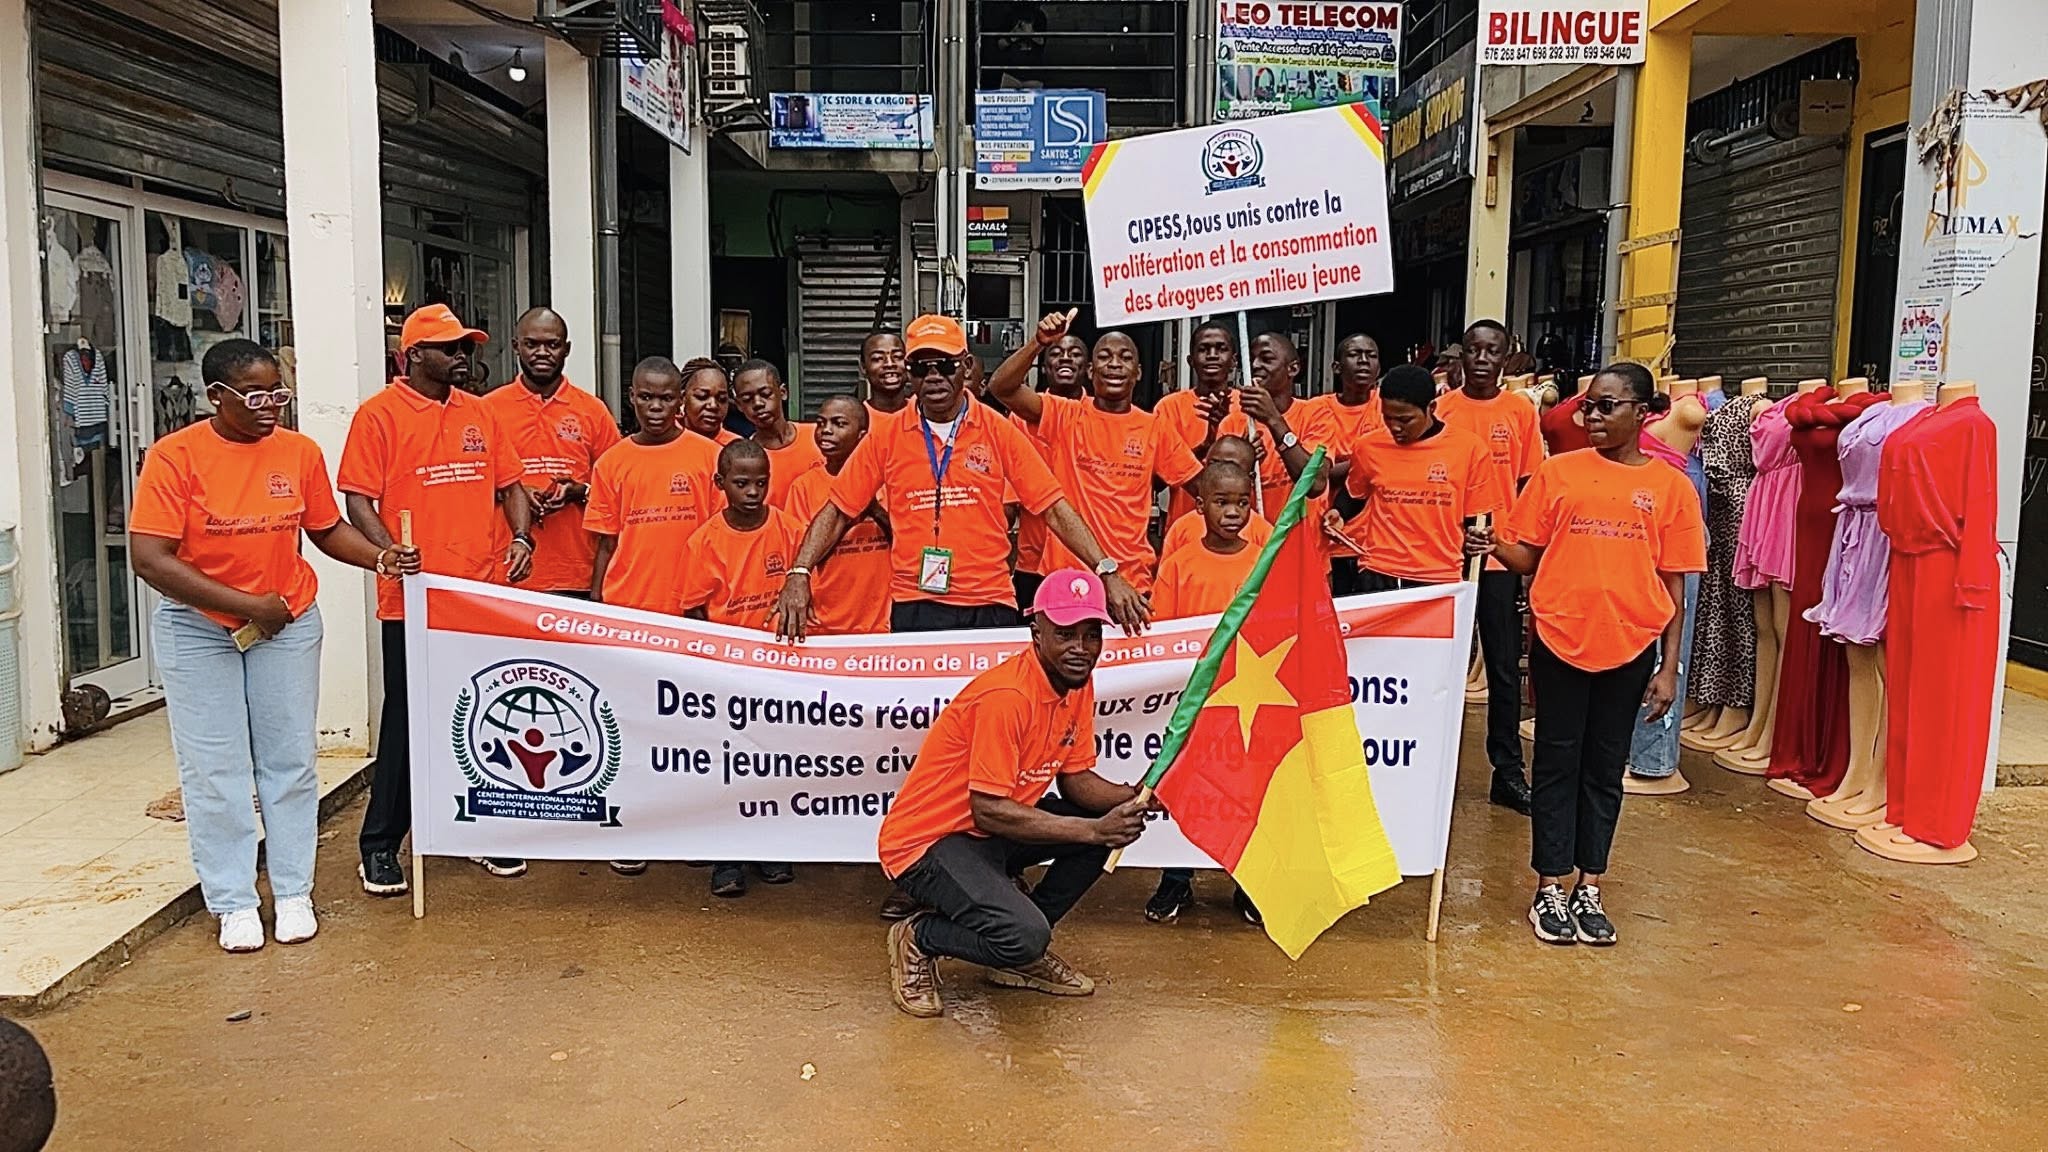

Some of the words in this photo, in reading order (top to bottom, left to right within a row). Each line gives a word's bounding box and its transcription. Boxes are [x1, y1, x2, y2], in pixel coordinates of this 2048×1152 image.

[1221, 3, 1270, 25] LEO
[1278, 4, 1398, 29] TELECOM
[1488, 11, 1640, 46] BILINGUE
[1235, 41, 1260, 51] Vente
[1262, 43, 1310, 54] Accessoires
[1485, 47, 1499, 60] 676
[1532, 47, 1547, 60] 698
[1549, 47, 1563, 60] 292
[1565, 47, 1579, 60] 337
[1583, 47, 1598, 60] 699
[1600, 47, 1614, 60] 546
[1616, 47, 1631, 60] 040
[822, 96, 833, 105] TC
[835, 96, 862, 105] STORE
[865, 96, 872, 105] &
[874, 96, 904, 105] CARGO
[1226, 202, 1262, 229] unis
[1266, 197, 1319, 224] contre
[1324, 190, 1342, 214] la
[968, 222, 1008, 231] CANAL+
[1103, 248, 1204, 288] prolifération
[1209, 248, 1226, 266] et
[1231, 240, 1247, 264] la
[1252, 222, 1378, 260] consommation
[1124, 288, 1153, 314] des
[1157, 282, 1224, 311] drogues
[1229, 280, 1250, 298] en
[1255, 268, 1308, 296] milieu
[1313, 262, 1362, 293] jeune
[537, 612, 680, 649] Célébration
[686, 639, 717, 656] de
[723, 642, 745, 660] la
[751, 649, 837, 670] 60ième
[844, 653, 926, 672] édition
[933, 653, 962, 671] de
[969, 652, 989, 670] la
[1101, 642, 1166, 662] onale
[1172, 639, 1202, 654] de
[501, 667, 570, 691] CIPESSS
[657, 679, 716, 720] Des
[727, 690, 864, 730] grandes
[1093, 697, 1136, 717] ux
[1348, 676, 1409, 705] ons:
[651, 746, 711, 773] une
[722, 740, 864, 785] jeunesse
[1363, 737, 1417, 767] our
[476, 791, 504, 799] CENTRE
[506, 792, 564, 804] INTERNATIONAL
[566, 796, 586, 805] POUR
[588, 798, 598, 806] LA
[478, 799, 523, 809] PROMOTION
[587, 805, 597, 813] LA
[739, 800, 779, 818] un
[791, 791, 897, 817] Camer
